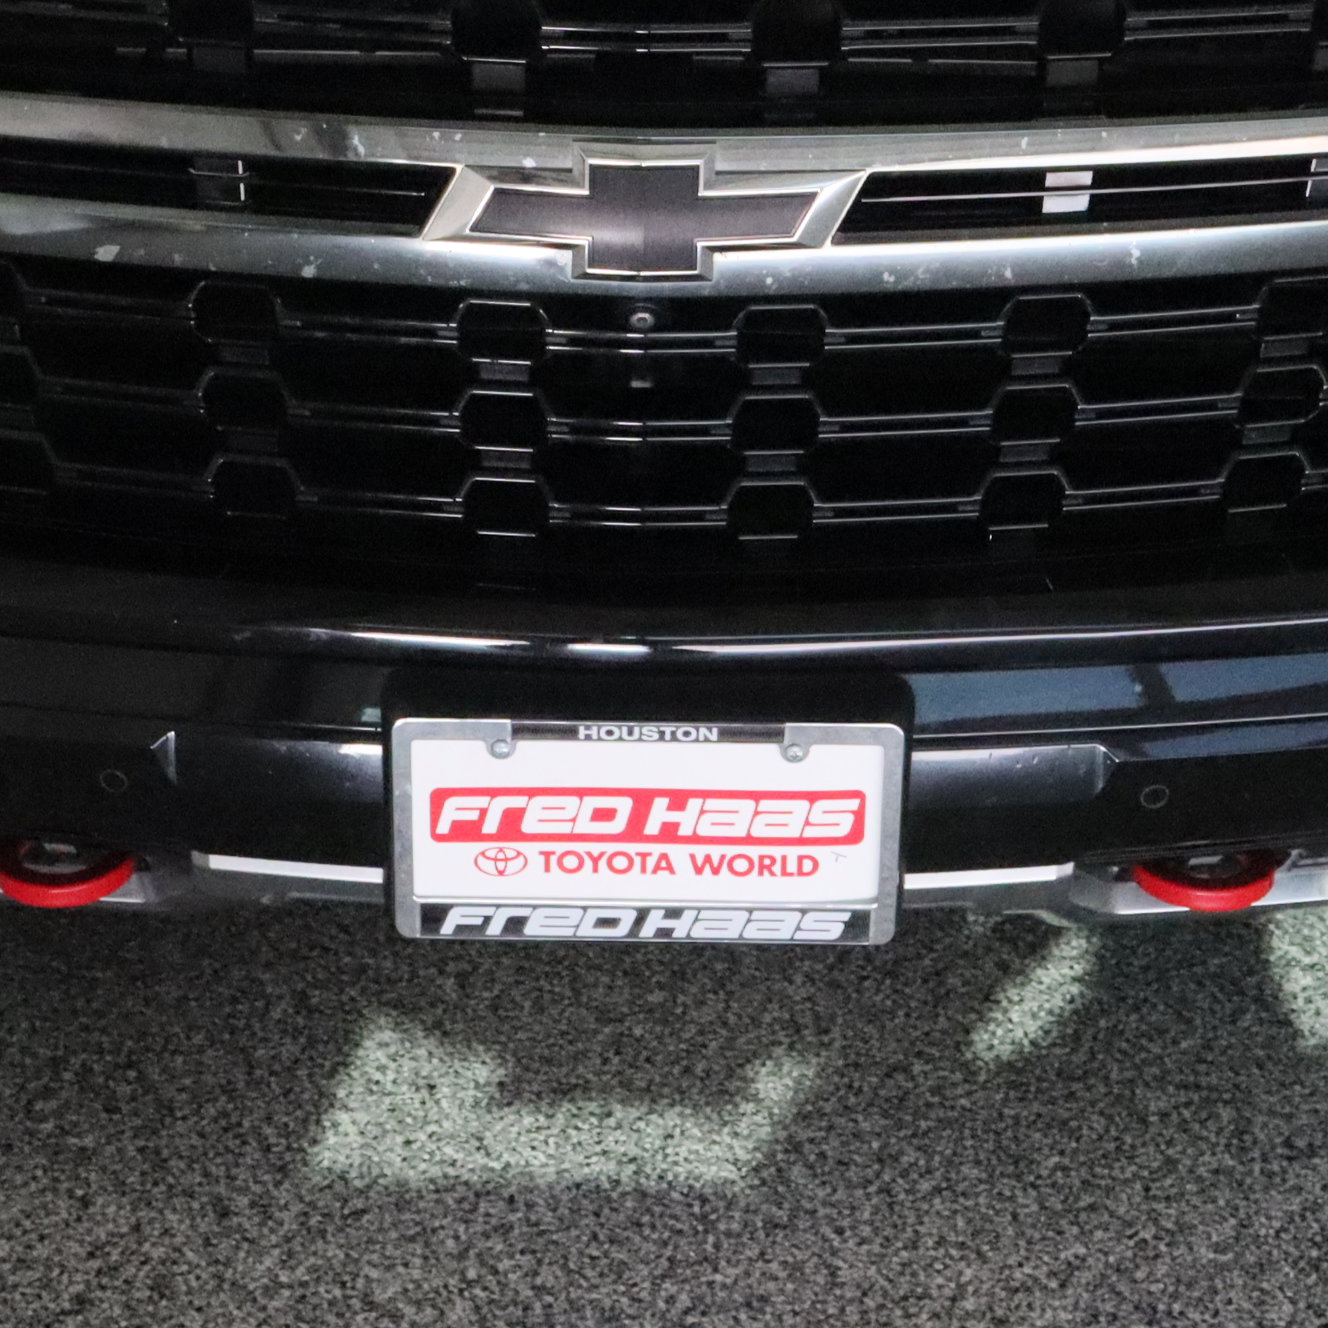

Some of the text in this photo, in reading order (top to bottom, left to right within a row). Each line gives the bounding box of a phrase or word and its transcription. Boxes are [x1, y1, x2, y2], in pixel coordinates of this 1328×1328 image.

[578, 726, 718, 742] HOUSTON
[538, 851, 819, 877] TOYOTA WORLD
